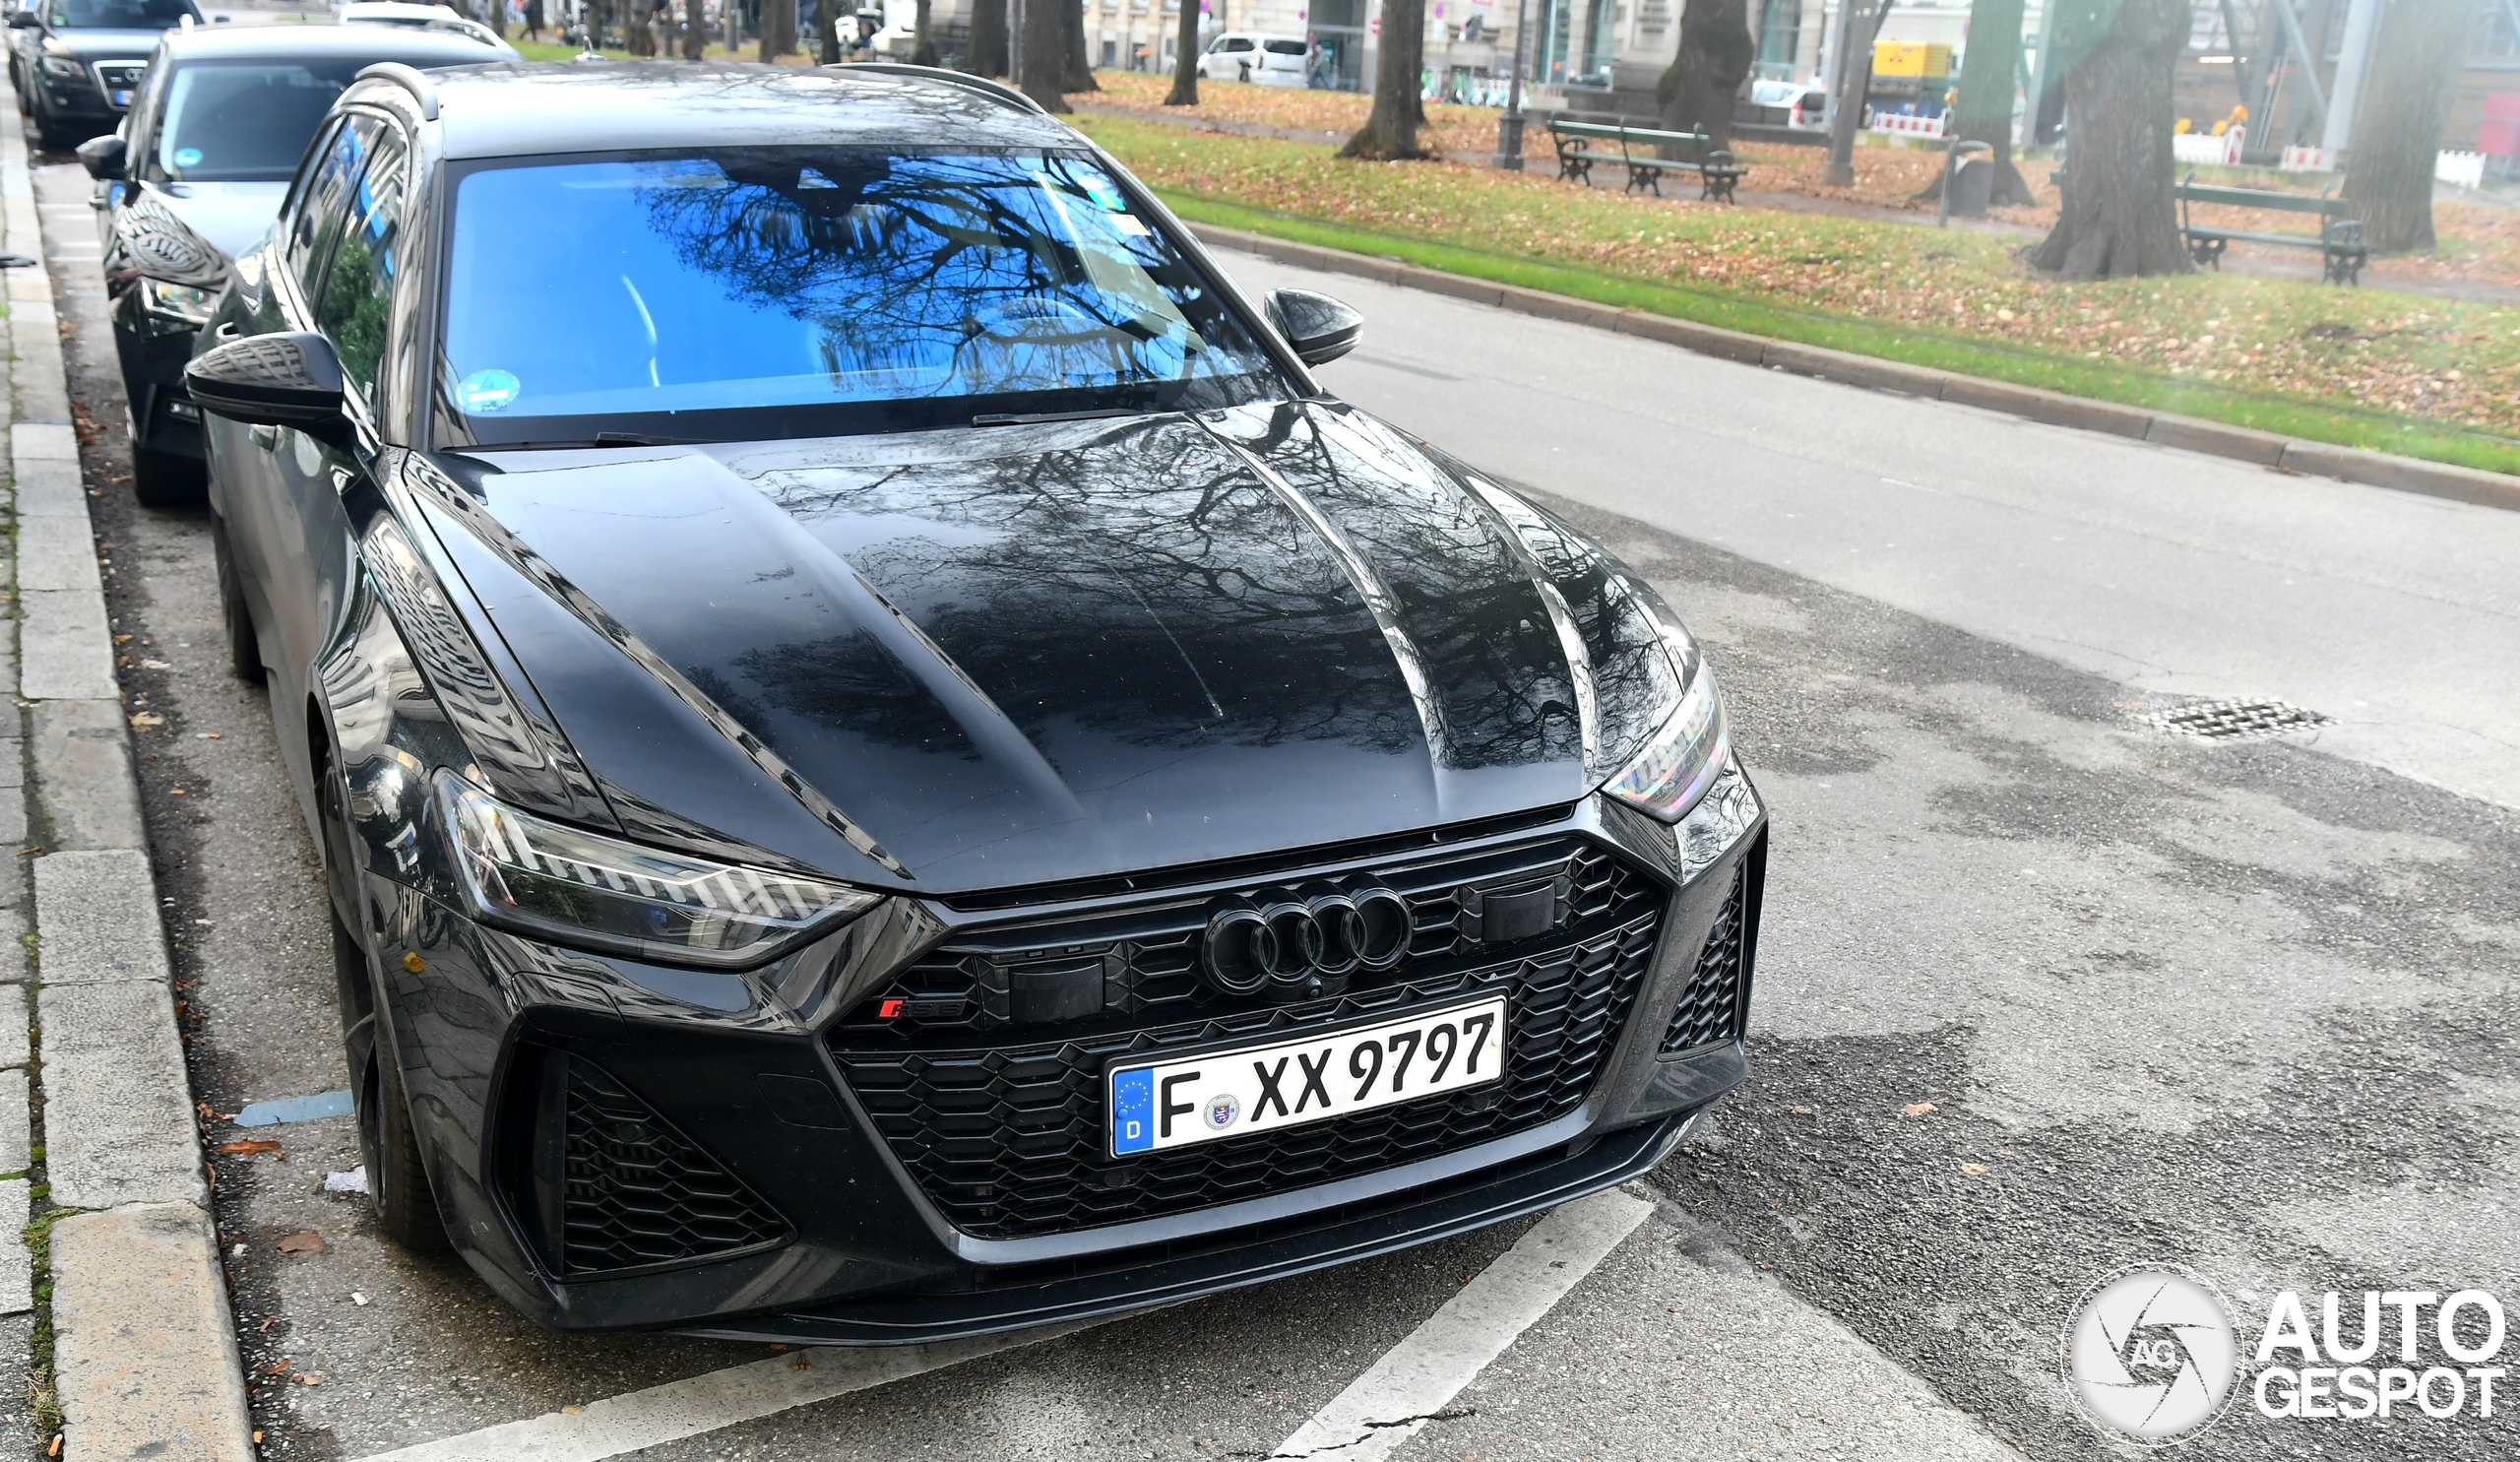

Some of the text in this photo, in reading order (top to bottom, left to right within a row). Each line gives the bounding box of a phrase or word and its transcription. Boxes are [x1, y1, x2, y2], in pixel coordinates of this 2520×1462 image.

[1161, 1071, 1201, 1138] F
[1250, 1048, 1332, 1122] XX
[1349, 1012, 1494, 1102] 9797
[1126, 1120, 1141, 1139] D
